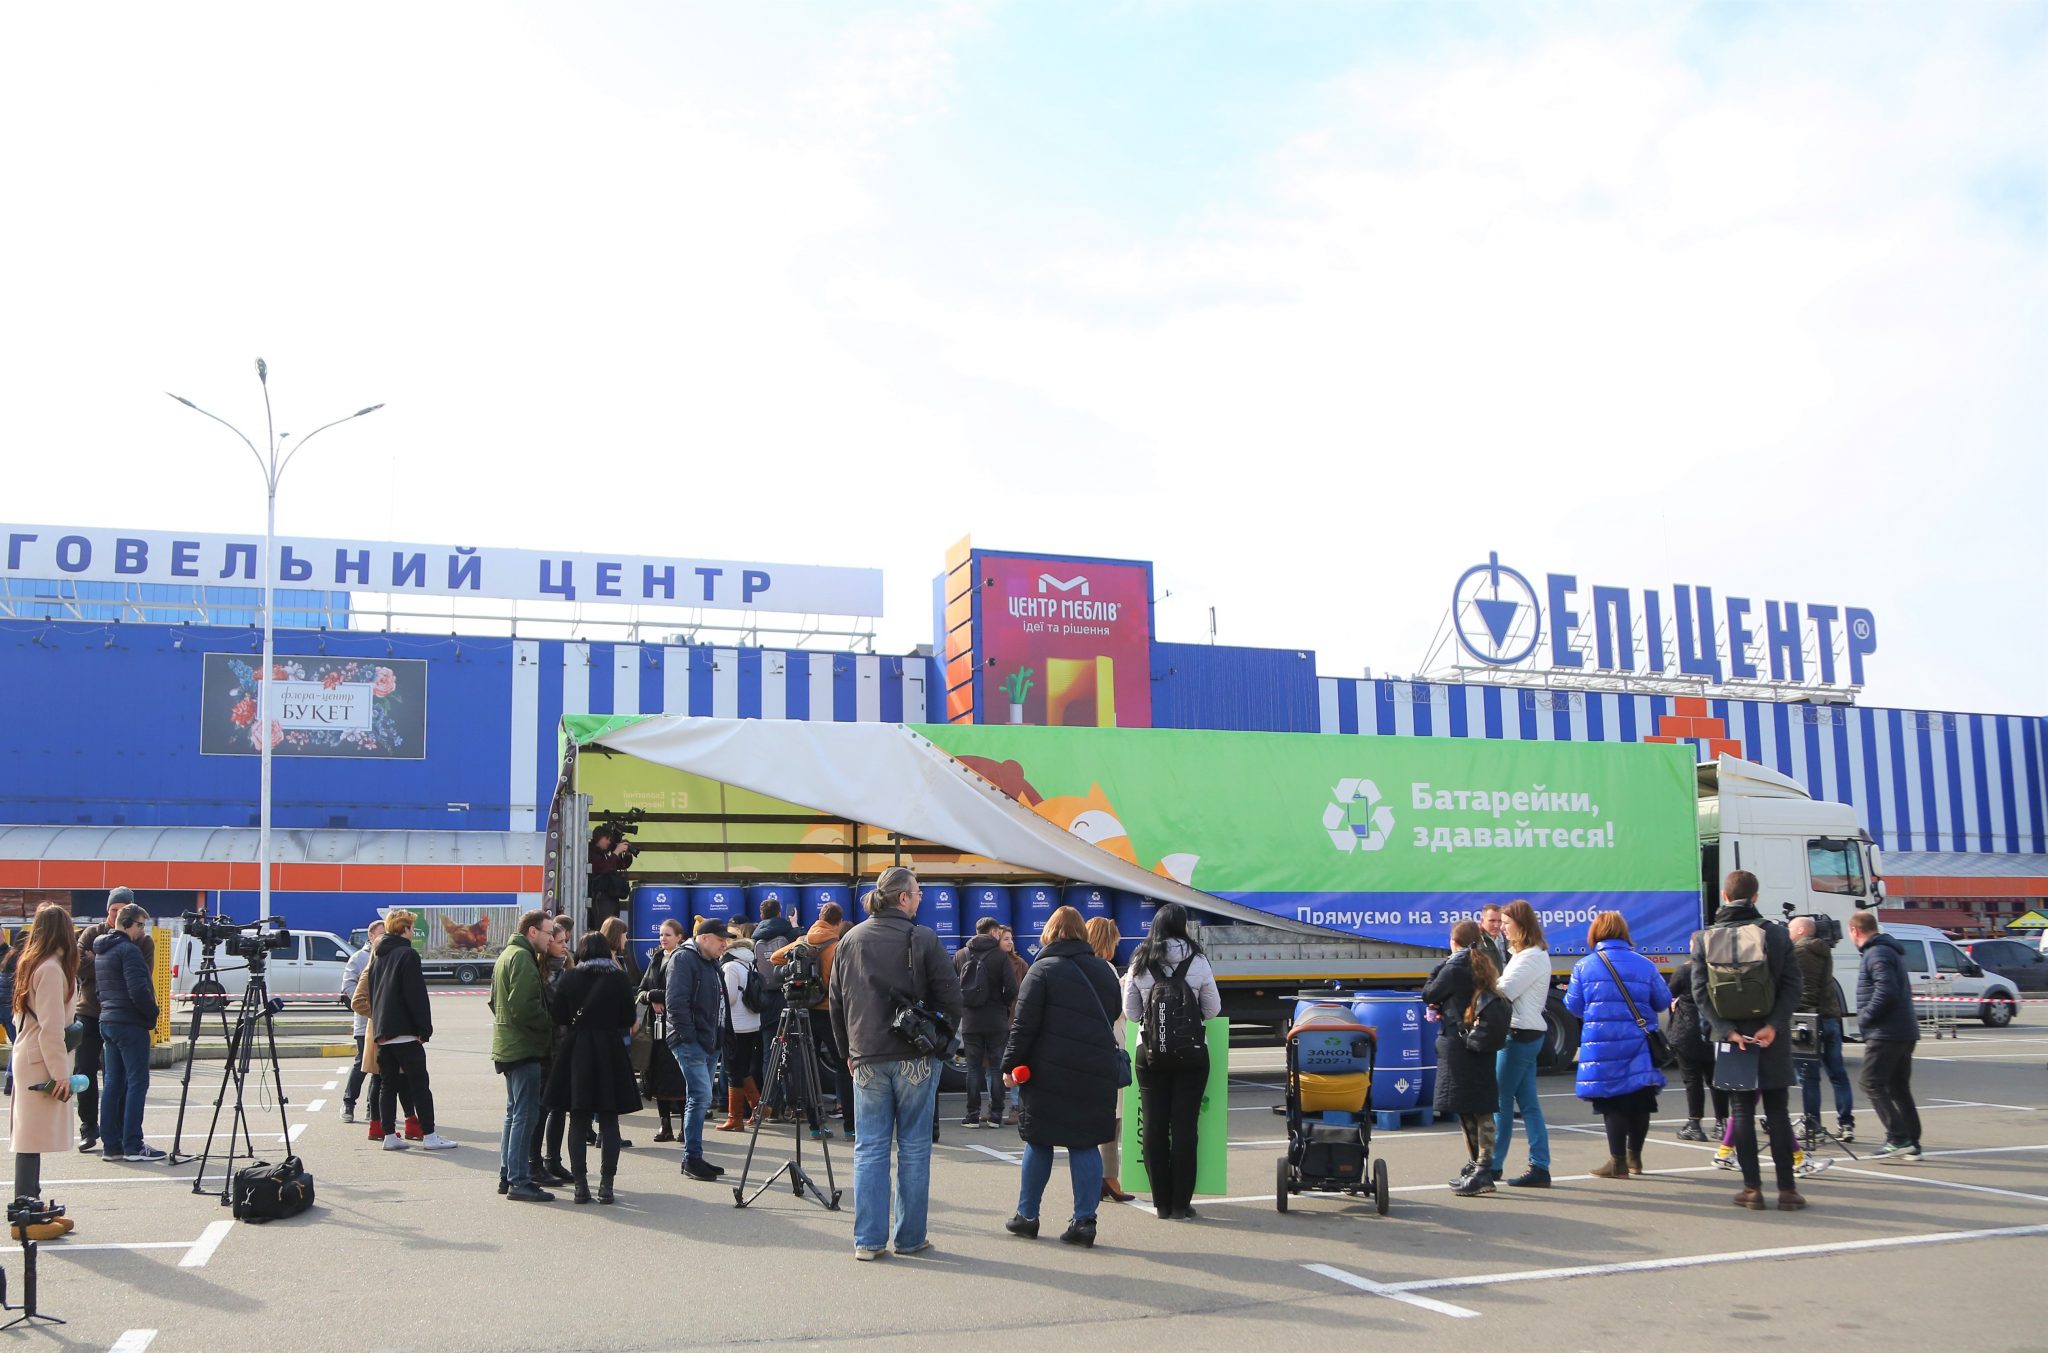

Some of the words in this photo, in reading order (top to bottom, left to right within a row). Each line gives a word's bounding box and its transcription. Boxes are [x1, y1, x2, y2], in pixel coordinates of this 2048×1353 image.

[7, 532, 482, 590] ГОВЕЛЬНИЙ
[539, 558, 772, 603] ЦЕНТР
[1008, 596, 1058, 618] ЦЕНТР
[1023, 620, 1045, 633] ідеї
[1047, 623, 1060, 633] та
[1063, 623, 1110, 636] рішення
[1545, 572, 1877, 687] ЕПІЦЕНТР
[281, 686, 355, 704] флора-центр
[282, 703, 355, 724] БУКЕТ
[1411, 782, 1600, 819] Батарейки,
[1412, 820, 1615, 853] здавайтеся!
[1296, 906, 1402, 930] Прямуємо
[1408, 911, 1433, 924] на
[1439, 910, 1482, 924] заво
[1306, 1057, 1353, 1065] 2207-1
